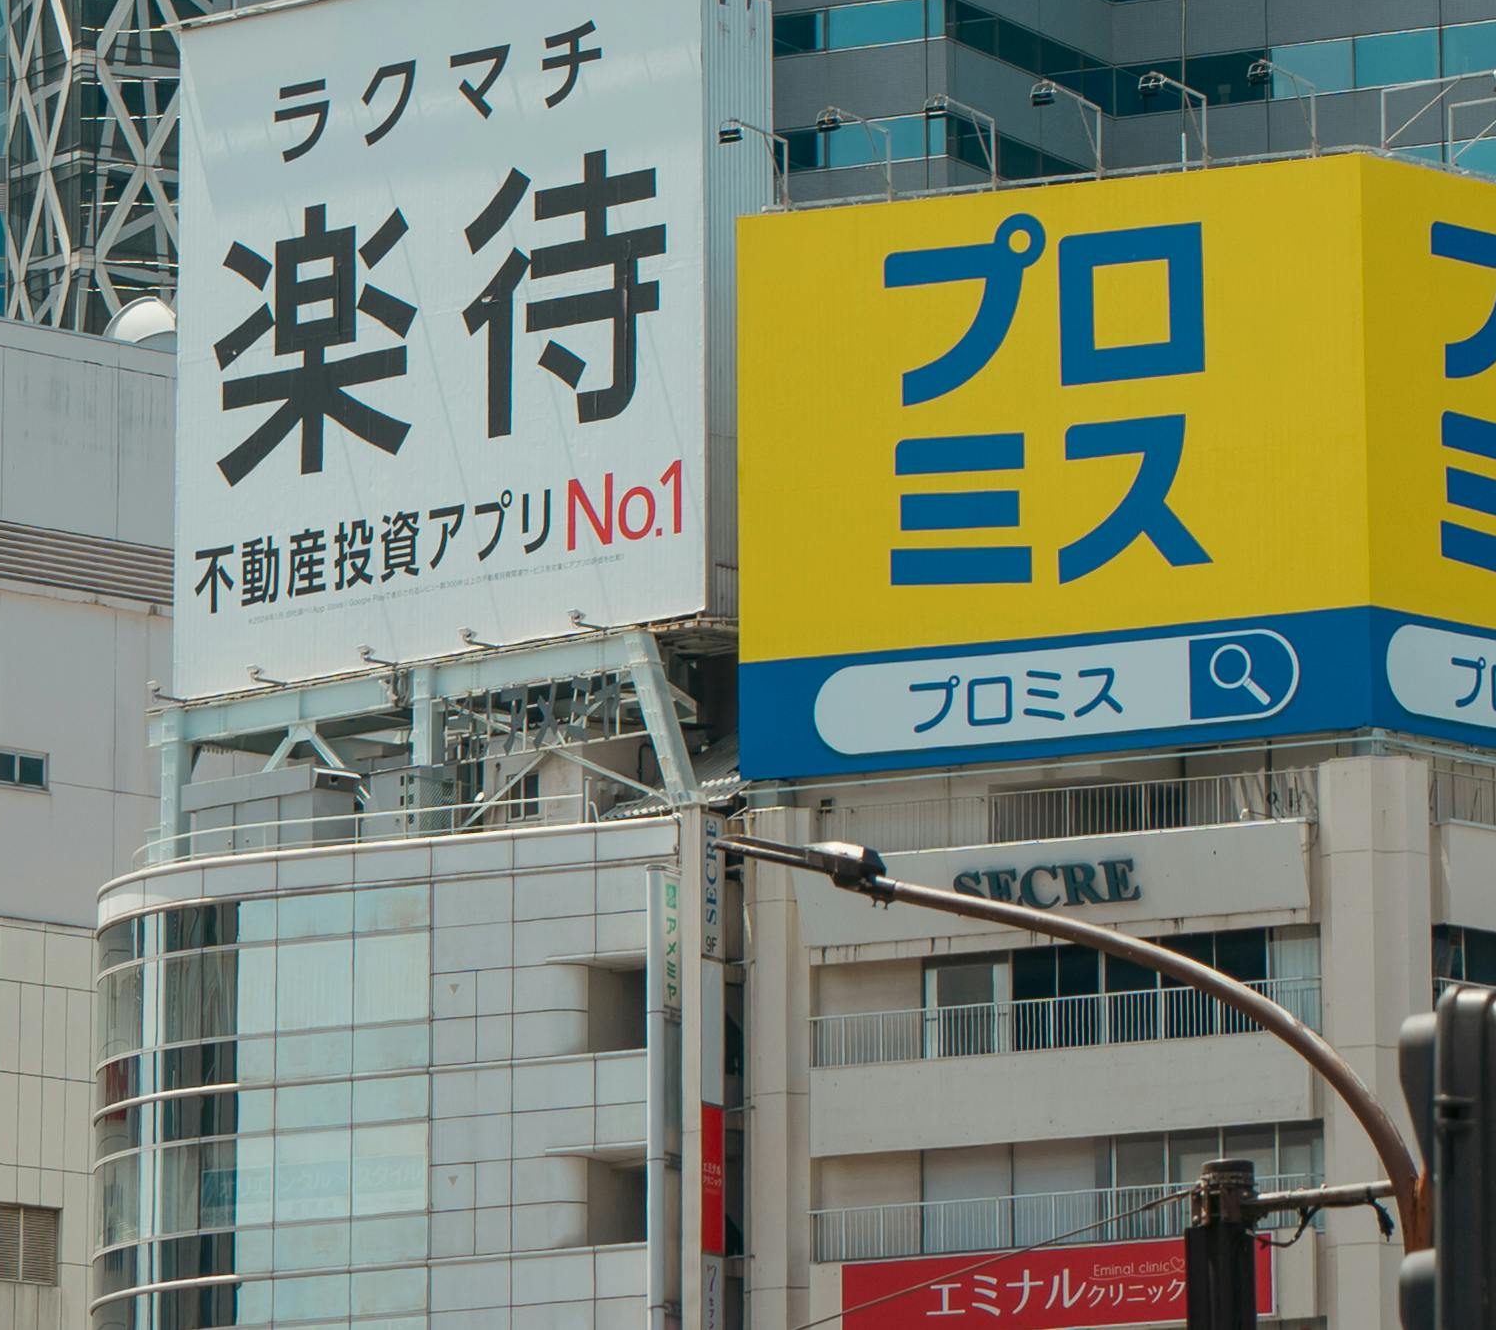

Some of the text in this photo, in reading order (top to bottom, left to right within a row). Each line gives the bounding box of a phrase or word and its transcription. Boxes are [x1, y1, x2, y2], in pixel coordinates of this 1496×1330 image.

[273, 19, 602, 163] ラクマチ
[213, 149, 667, 489] 楽待
[883, 212, 1206, 407] プロ
[889, 413, 1214, 586] ミス
[908, 666, 1125, 735] プロミス
[705, 820, 718, 927] SECRE
[953, 857, 1142, 908] SECRE
[1092, 1258, 1170, 1278] Eminal clinic
